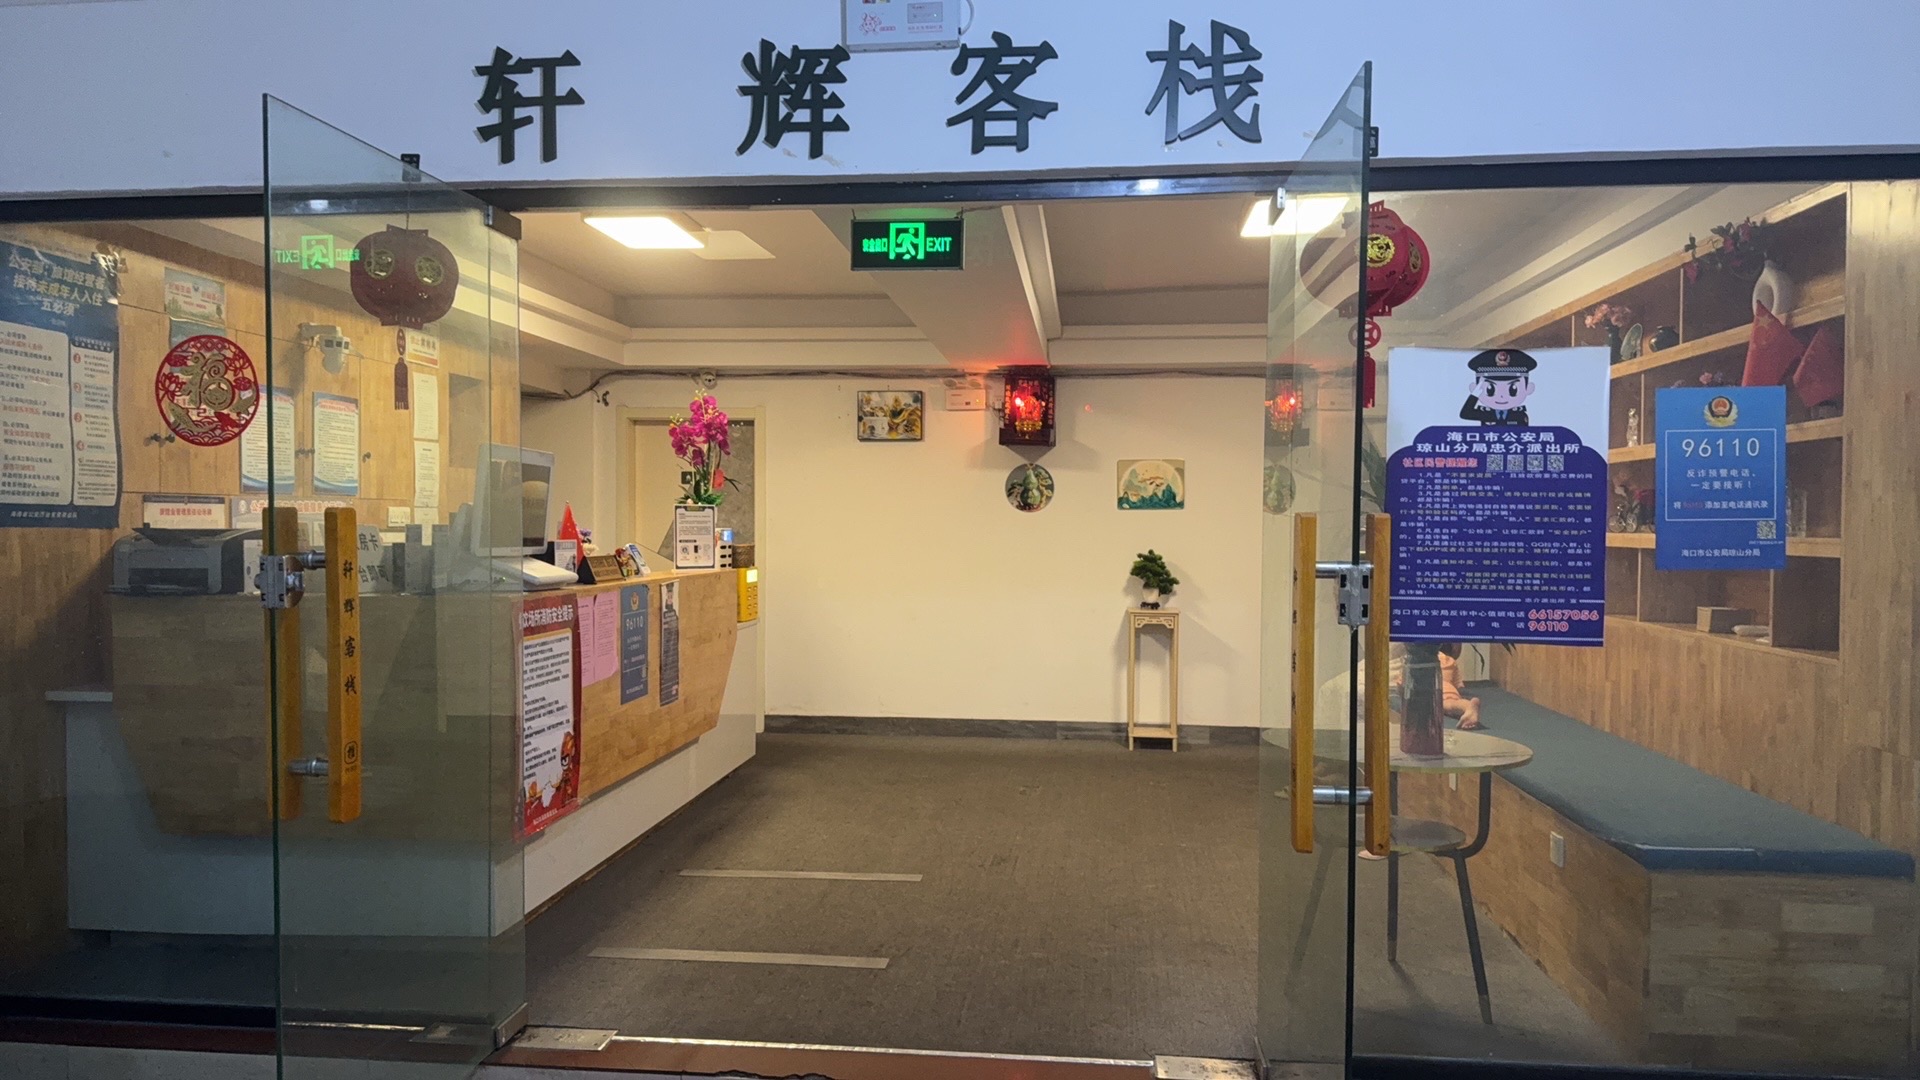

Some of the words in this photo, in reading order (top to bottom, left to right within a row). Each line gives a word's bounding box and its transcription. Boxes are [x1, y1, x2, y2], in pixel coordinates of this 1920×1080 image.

[474, 19, 1263, 164] 轩辉客栈
[926, 237, 952, 252] EXIT
[13, 274, 104, 307] 接待未成年人入住
[1446, 431, 1555, 443] 海口市公安局
[1416, 442, 1580, 455] 琼山分局忠介派出所
[1681, 437, 1760, 458] 96110
[1673, 501, 1682, 510] 将
[1705, 501, 1769, 510] 添加至电话通讯录
[357, 532, 379, 551] 房卡
[1681, 549, 1761, 558] 海口市公安局琼山分局
[1392, 608, 1526, 619] 海口市公安局反诈中心值班电话
[1527, 608, 1600, 621] 66157056
[626, 615, 644, 631] 96110
[1392, 619, 1526, 629] 全国反诈电话
[1527, 620, 1569, 632] 96110
